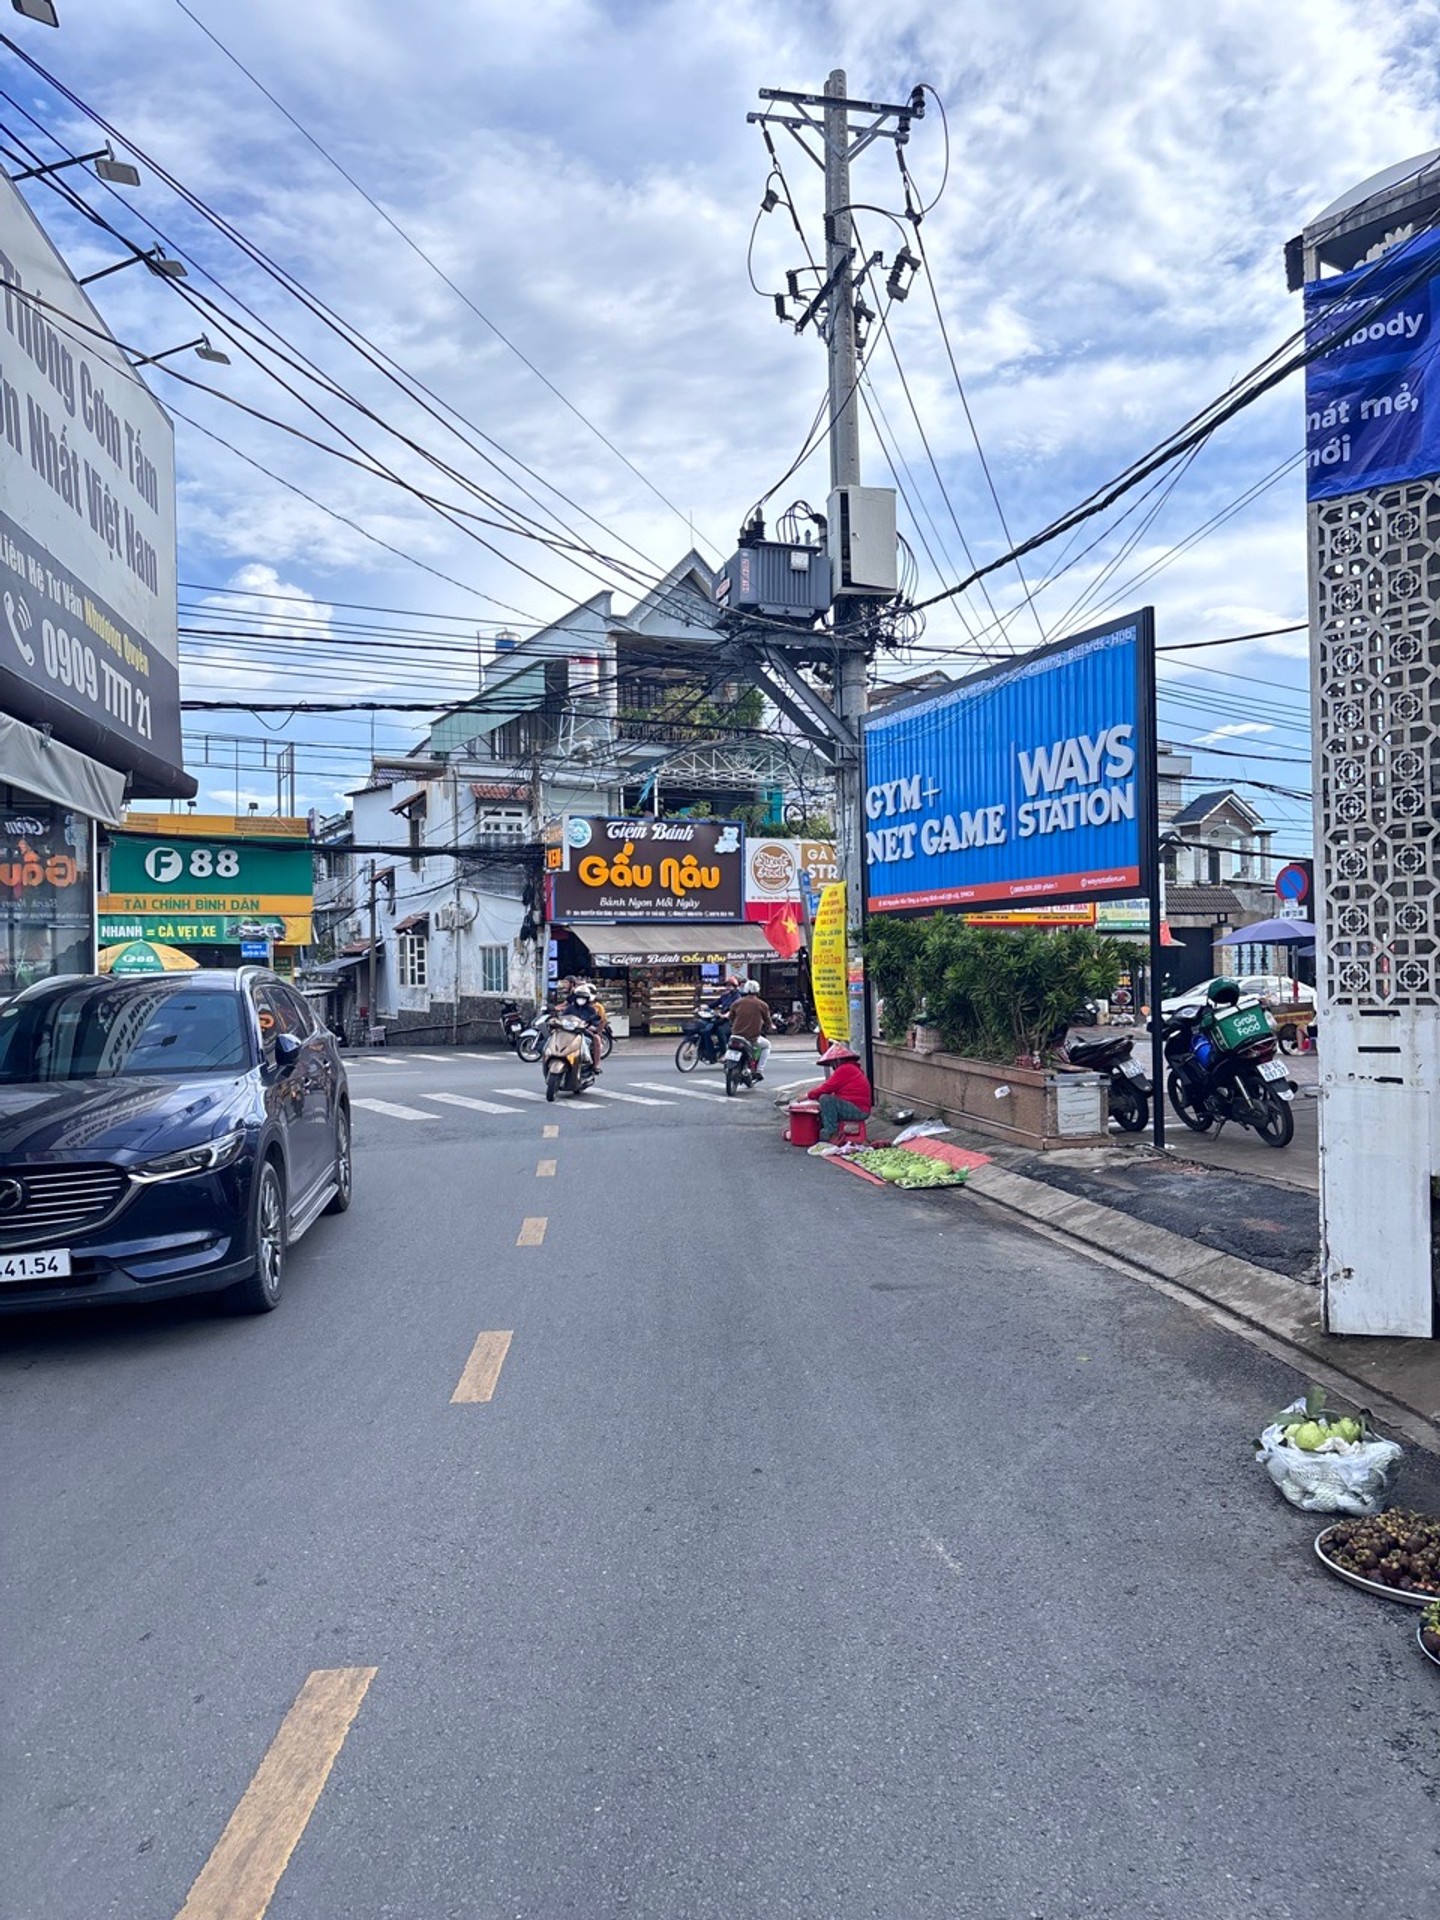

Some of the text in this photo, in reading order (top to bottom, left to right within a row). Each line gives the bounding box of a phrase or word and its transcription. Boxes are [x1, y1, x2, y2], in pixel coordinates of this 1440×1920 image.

[80, 361, 122, 470] Cơm
[124, 419, 158, 515] Tấm
[27, 393, 82, 517] Nhất
[84, 458, 122, 561] Việt
[124, 506, 158, 597] Nam
[27, 554, 45, 598] Hệ
[45, 569, 62, 605] Tư
[62, 581, 83, 621] Vấn
[42, 618, 152, 741] 0909 7777 21
[1018, 724, 1136, 797] WAYS
[1018, 783, 1135, 838] STATION
[606, 821, 695, 842] Tiệm Bánh
[866, 822, 918, 865] NET
[921, 804, 1008, 856] GAME
[807, 846, 829, 861] GÀ
[578, 842, 653, 888] Gấu
[660, 854, 721, 897] Nâu
[807, 863, 839, 880] STR
[124, 898, 260, 911] TÀI CHÍNH BÌNH DÂN
[600, 897, 626, 907] Bánh
[628, 898, 653, 909] Ngon
[676, 898, 700, 910] Ngày
[101, 925, 143, 938] NHANH
[158, 922, 175, 938] CÀ
[178, 925, 199, 941] VẸT
[201, 925, 217, 938] XE
[611, 954, 642, 966] Tiệm
[647, 953, 681, 964] Bánh
[1233, 1013, 1257, 1028] Grab
[1237, 1021, 1261, 1036] Food
[0, 1256, 59, 1275] 41.54
